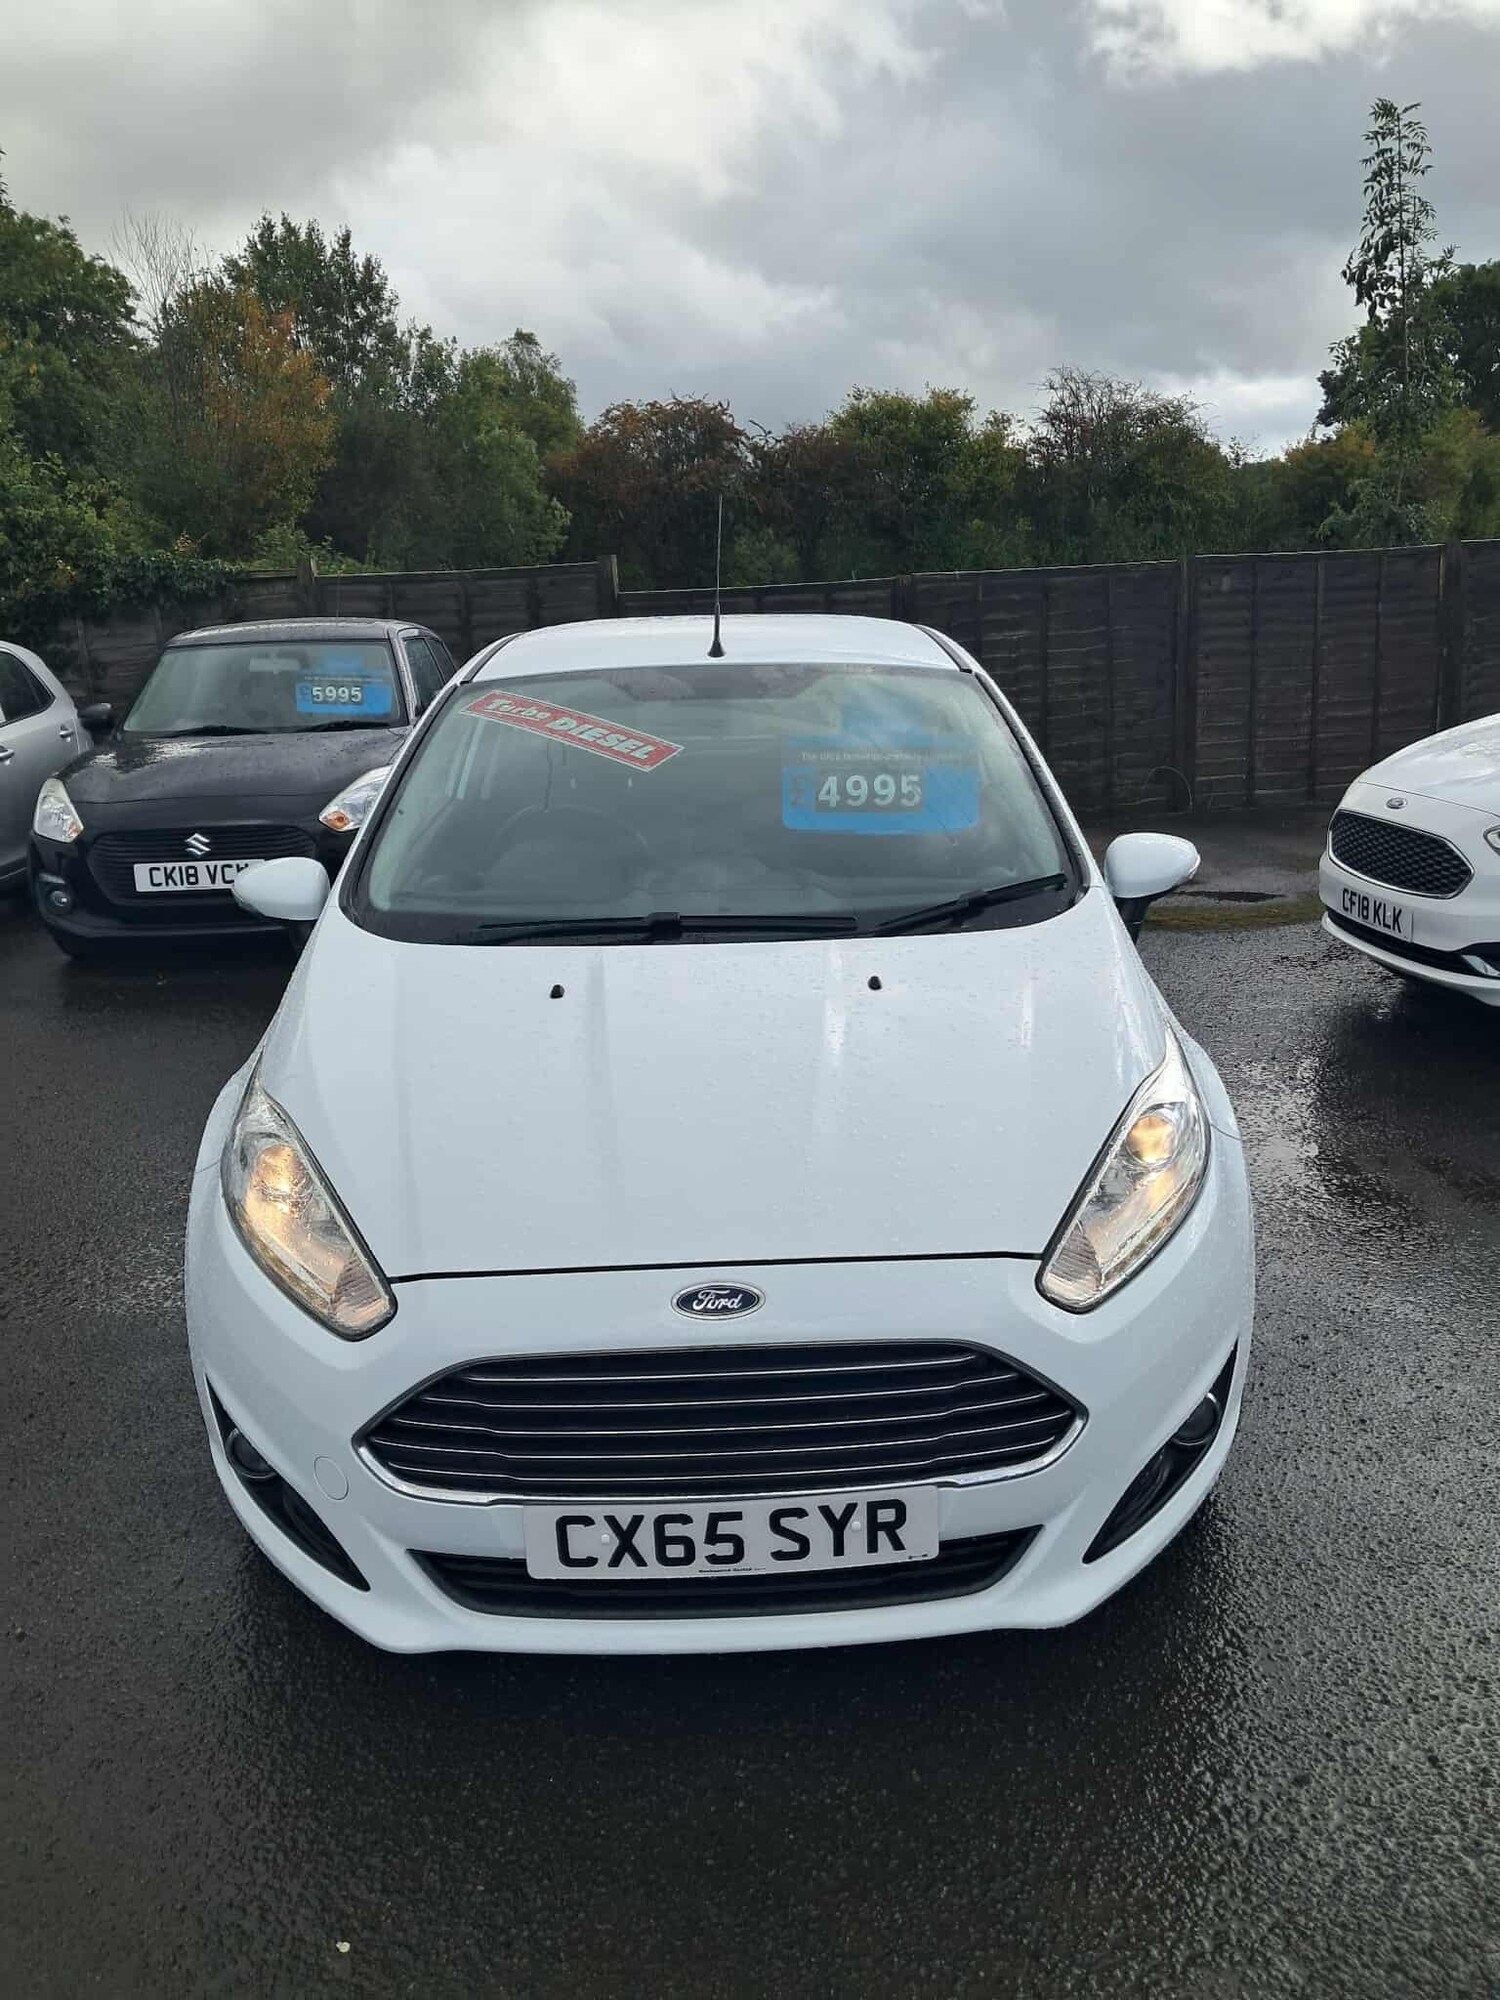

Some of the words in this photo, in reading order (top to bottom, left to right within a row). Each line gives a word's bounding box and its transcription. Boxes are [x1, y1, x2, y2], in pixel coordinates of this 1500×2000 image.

[312, 686, 362, 702] 5995
[547, 716, 654, 760] DIESEL
[818, 774, 922, 807] 4995
[149, 865, 199, 887] CK18
[1342, 888, 1370, 920] CF18
[1373, 899, 1402, 934] KLK
[692, 1289, 743, 1310] Ford
[555, 1511, 745, 1568] CX65
[769, 1499, 907, 1560] SYR
